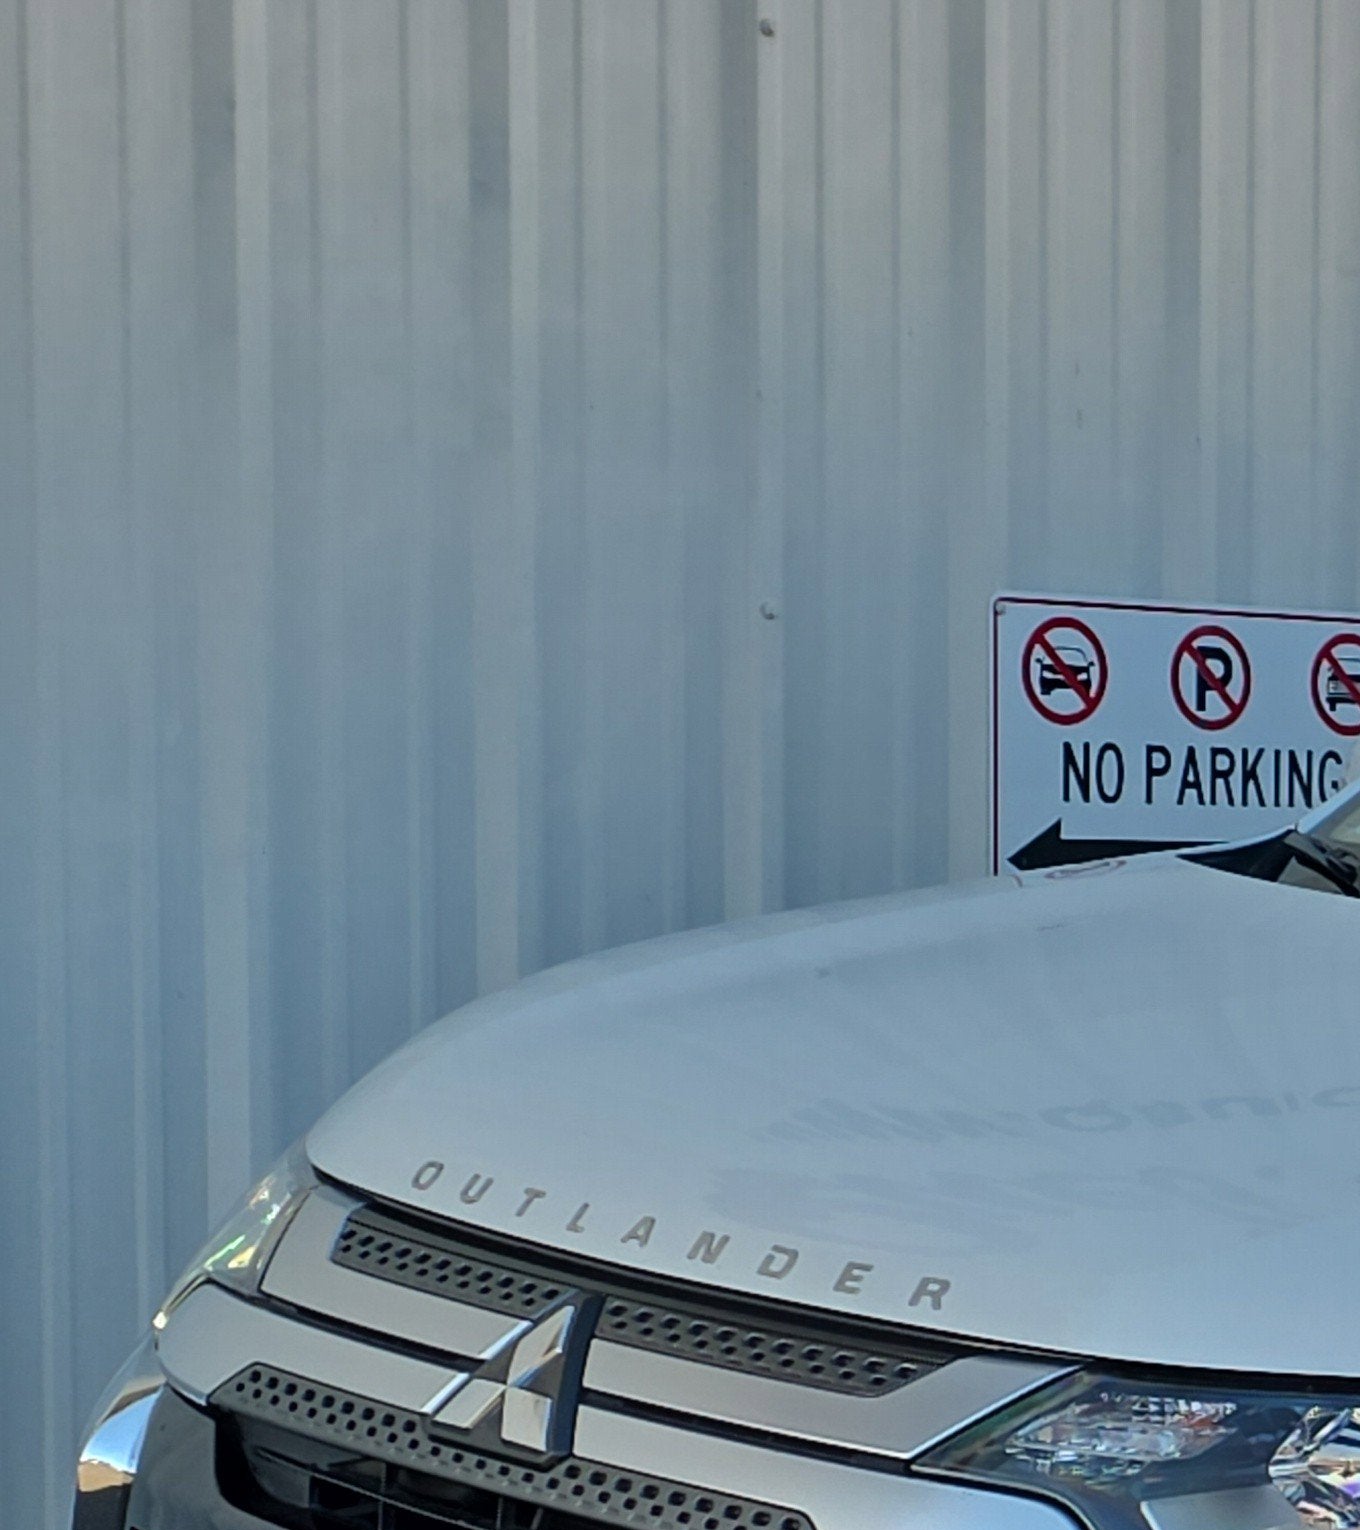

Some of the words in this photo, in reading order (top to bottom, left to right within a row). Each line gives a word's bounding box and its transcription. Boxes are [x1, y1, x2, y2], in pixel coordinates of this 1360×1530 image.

[1061, 741, 1125, 803] NO
[1144, 743, 1343, 808] PARKING
[410, 1160, 953, 1310] OUTLANDER
